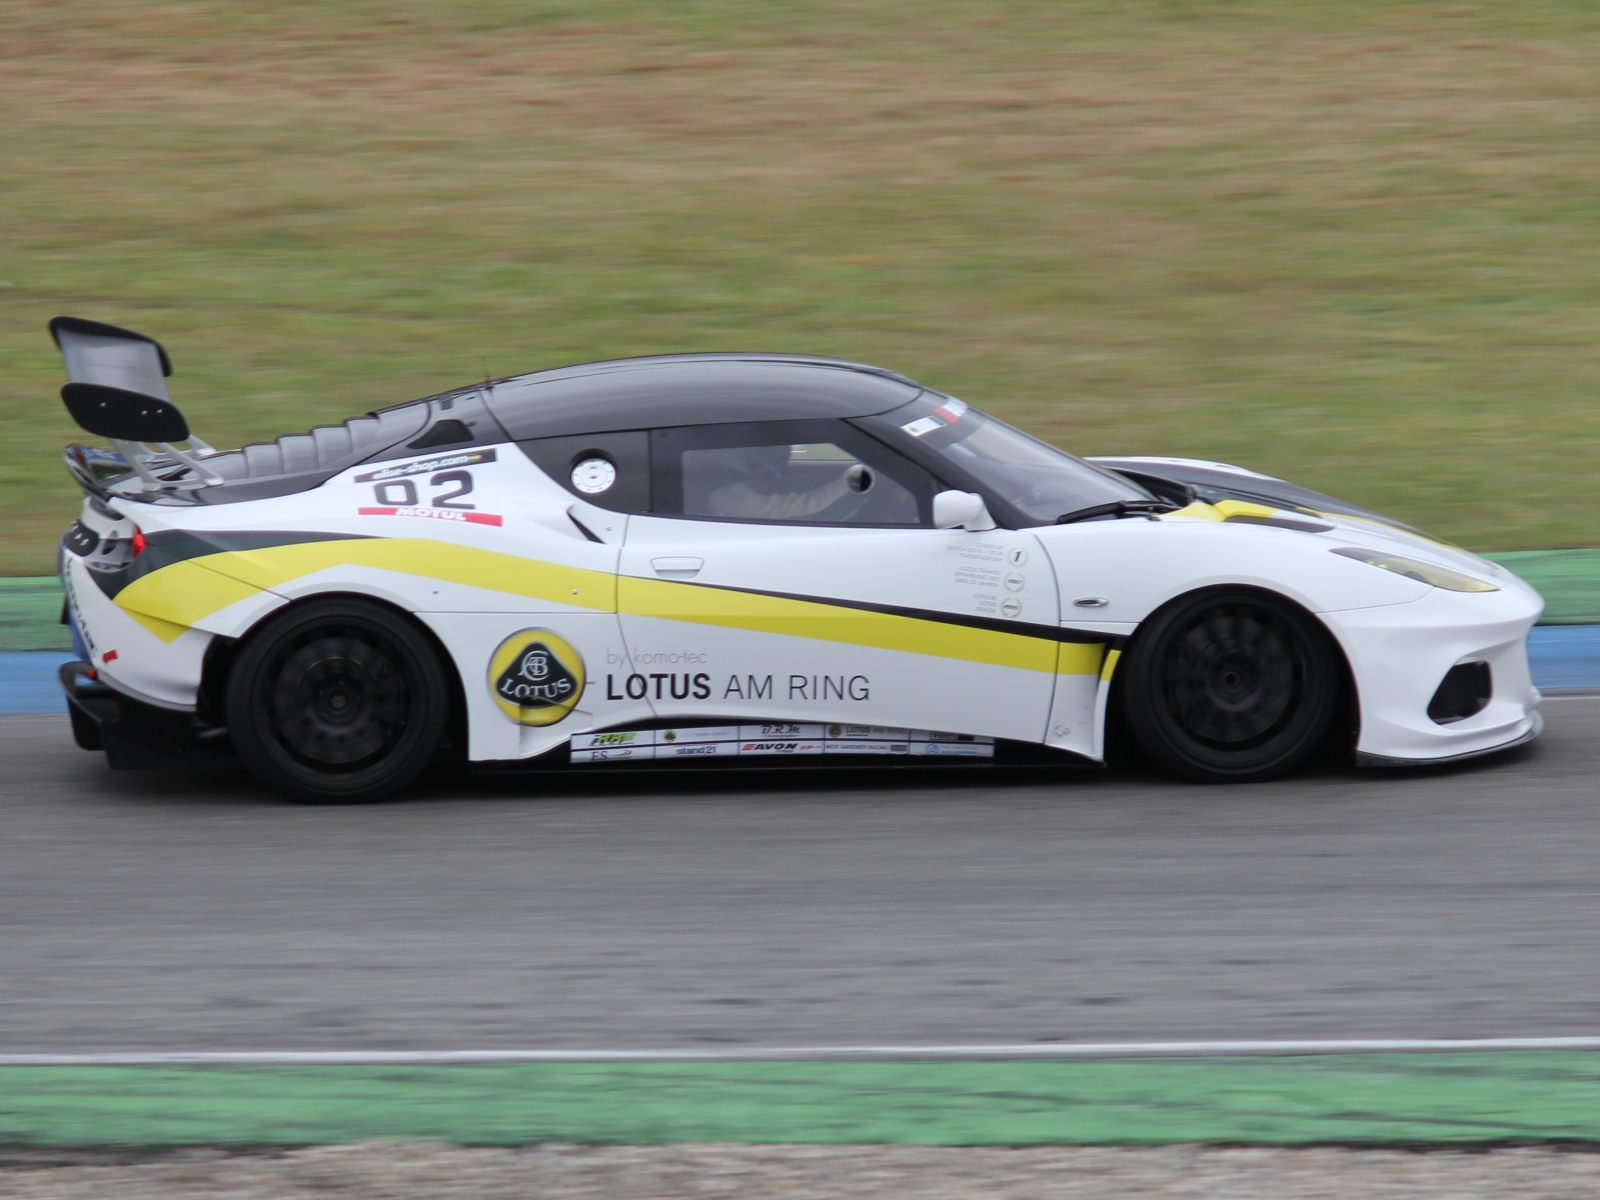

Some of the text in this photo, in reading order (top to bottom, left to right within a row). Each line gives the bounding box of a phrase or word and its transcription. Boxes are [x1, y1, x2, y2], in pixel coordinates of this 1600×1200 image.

[372, 455, 468, 479] elise-shop.com
[373, 470, 476, 509] 02
[395, 507, 466, 521] MOTUL
[1014, 551, 1022, 562] 1
[606, 647, 708, 665] by komo-tec
[500, 678, 571, 700] LOTUS
[607, 674, 870, 701] LOTUS AM RING
[846, 726, 871, 734] LOTUS
[591, 751, 608, 761] ES
